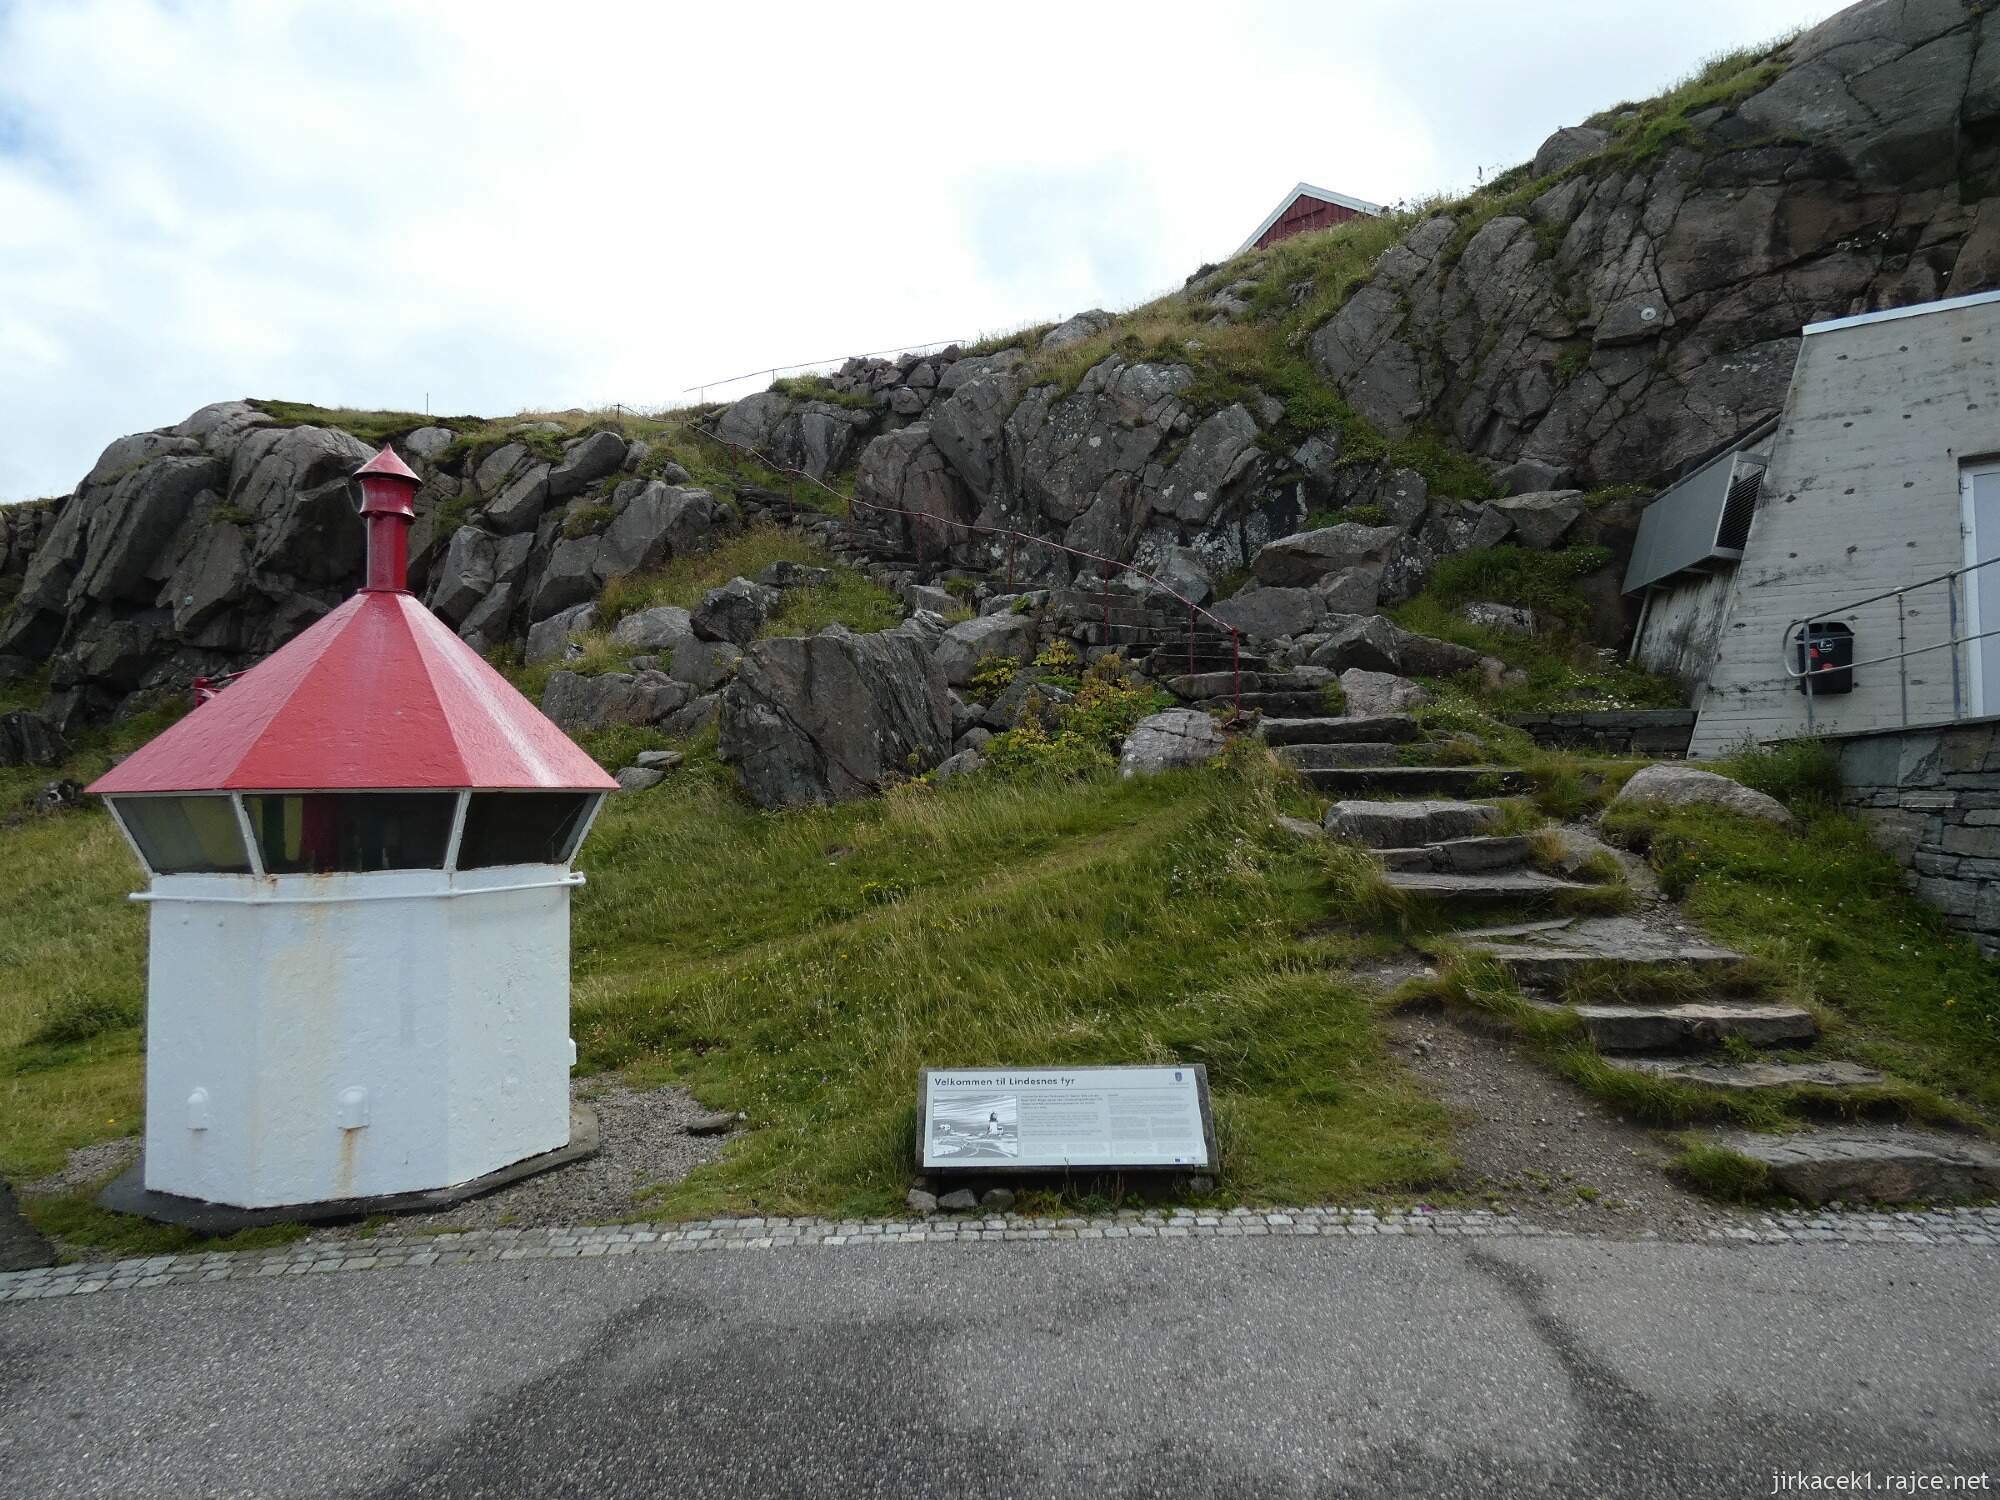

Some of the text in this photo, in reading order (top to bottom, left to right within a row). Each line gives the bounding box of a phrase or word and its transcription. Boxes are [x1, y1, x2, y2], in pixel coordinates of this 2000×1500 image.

[934, 1076, 1076, 1087] Velkommen til Lindesnes fyr
